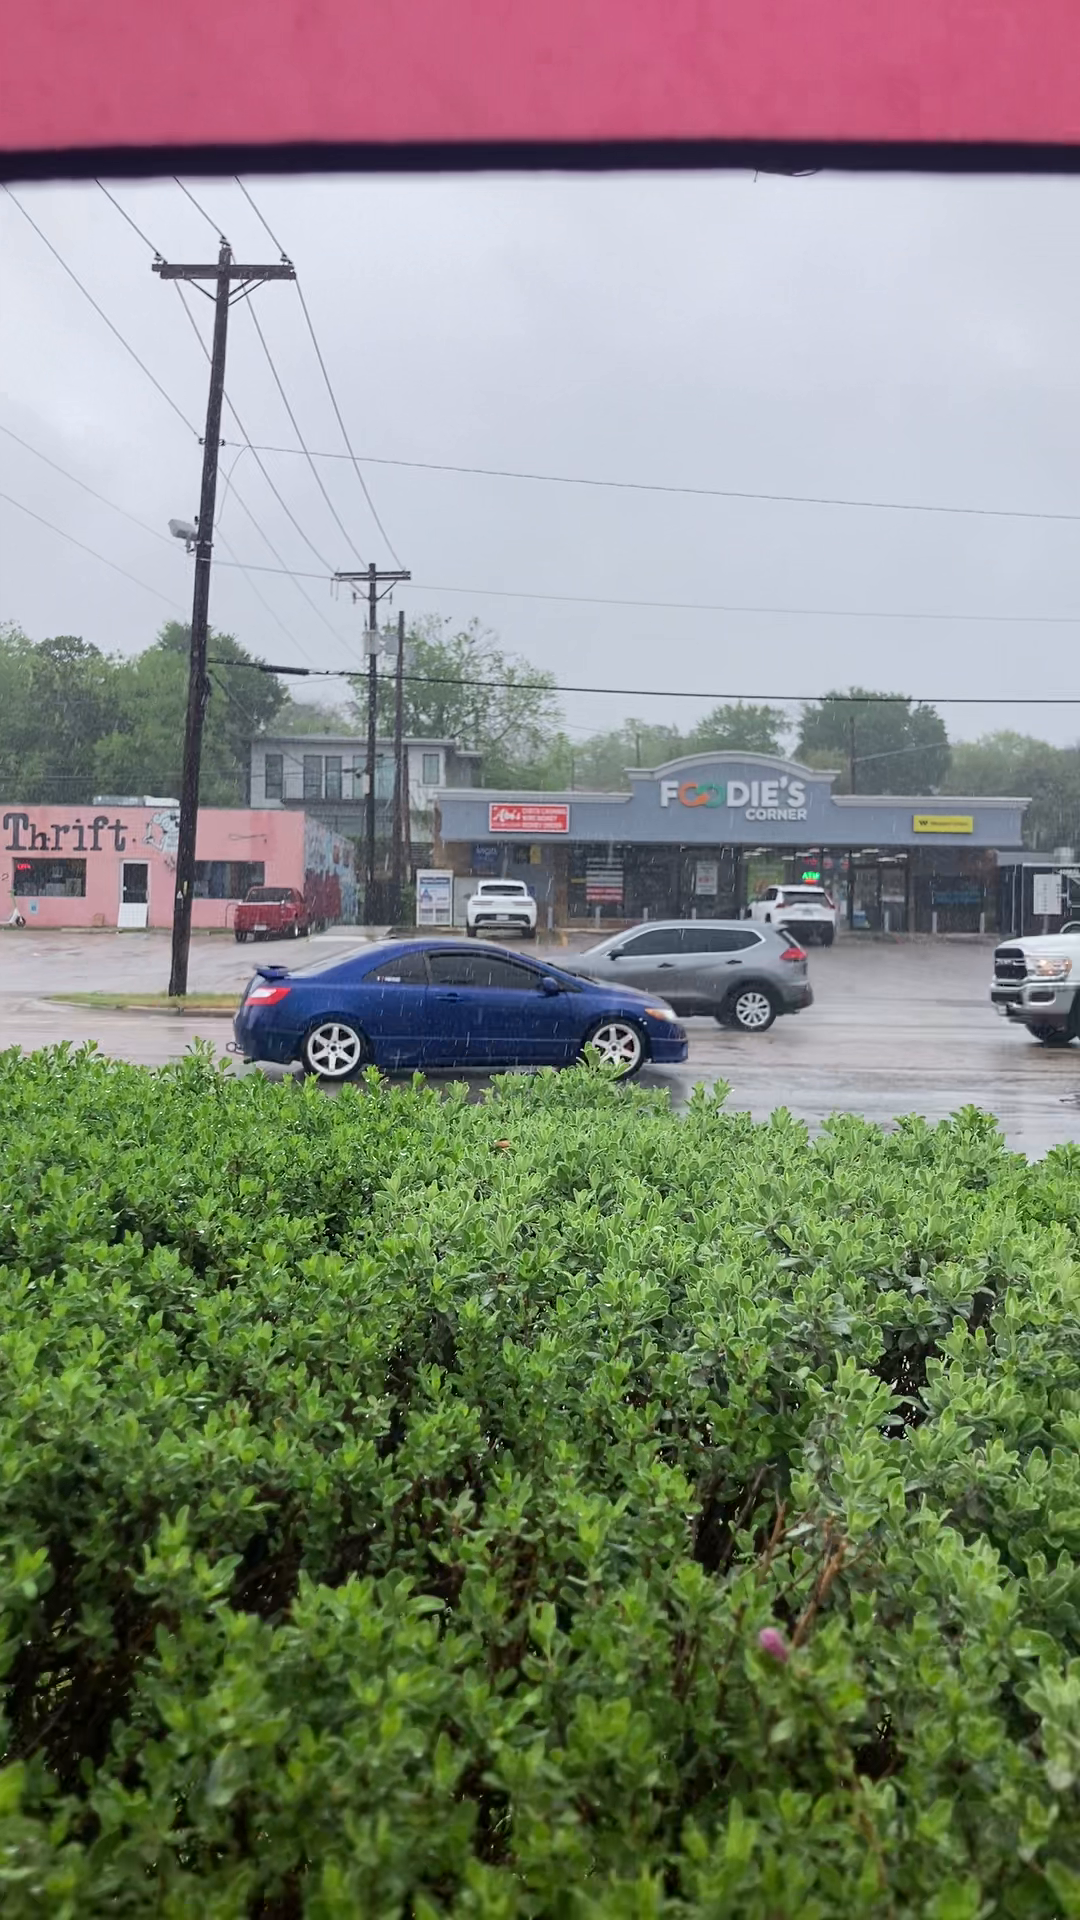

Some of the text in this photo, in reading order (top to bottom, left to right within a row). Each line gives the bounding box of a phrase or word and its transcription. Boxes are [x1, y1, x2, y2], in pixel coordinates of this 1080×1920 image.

[660, 776, 806, 807] FOODIE'S
[745, 808, 808, 821] CORNER
[3, 812, 128, 852] Thrift
